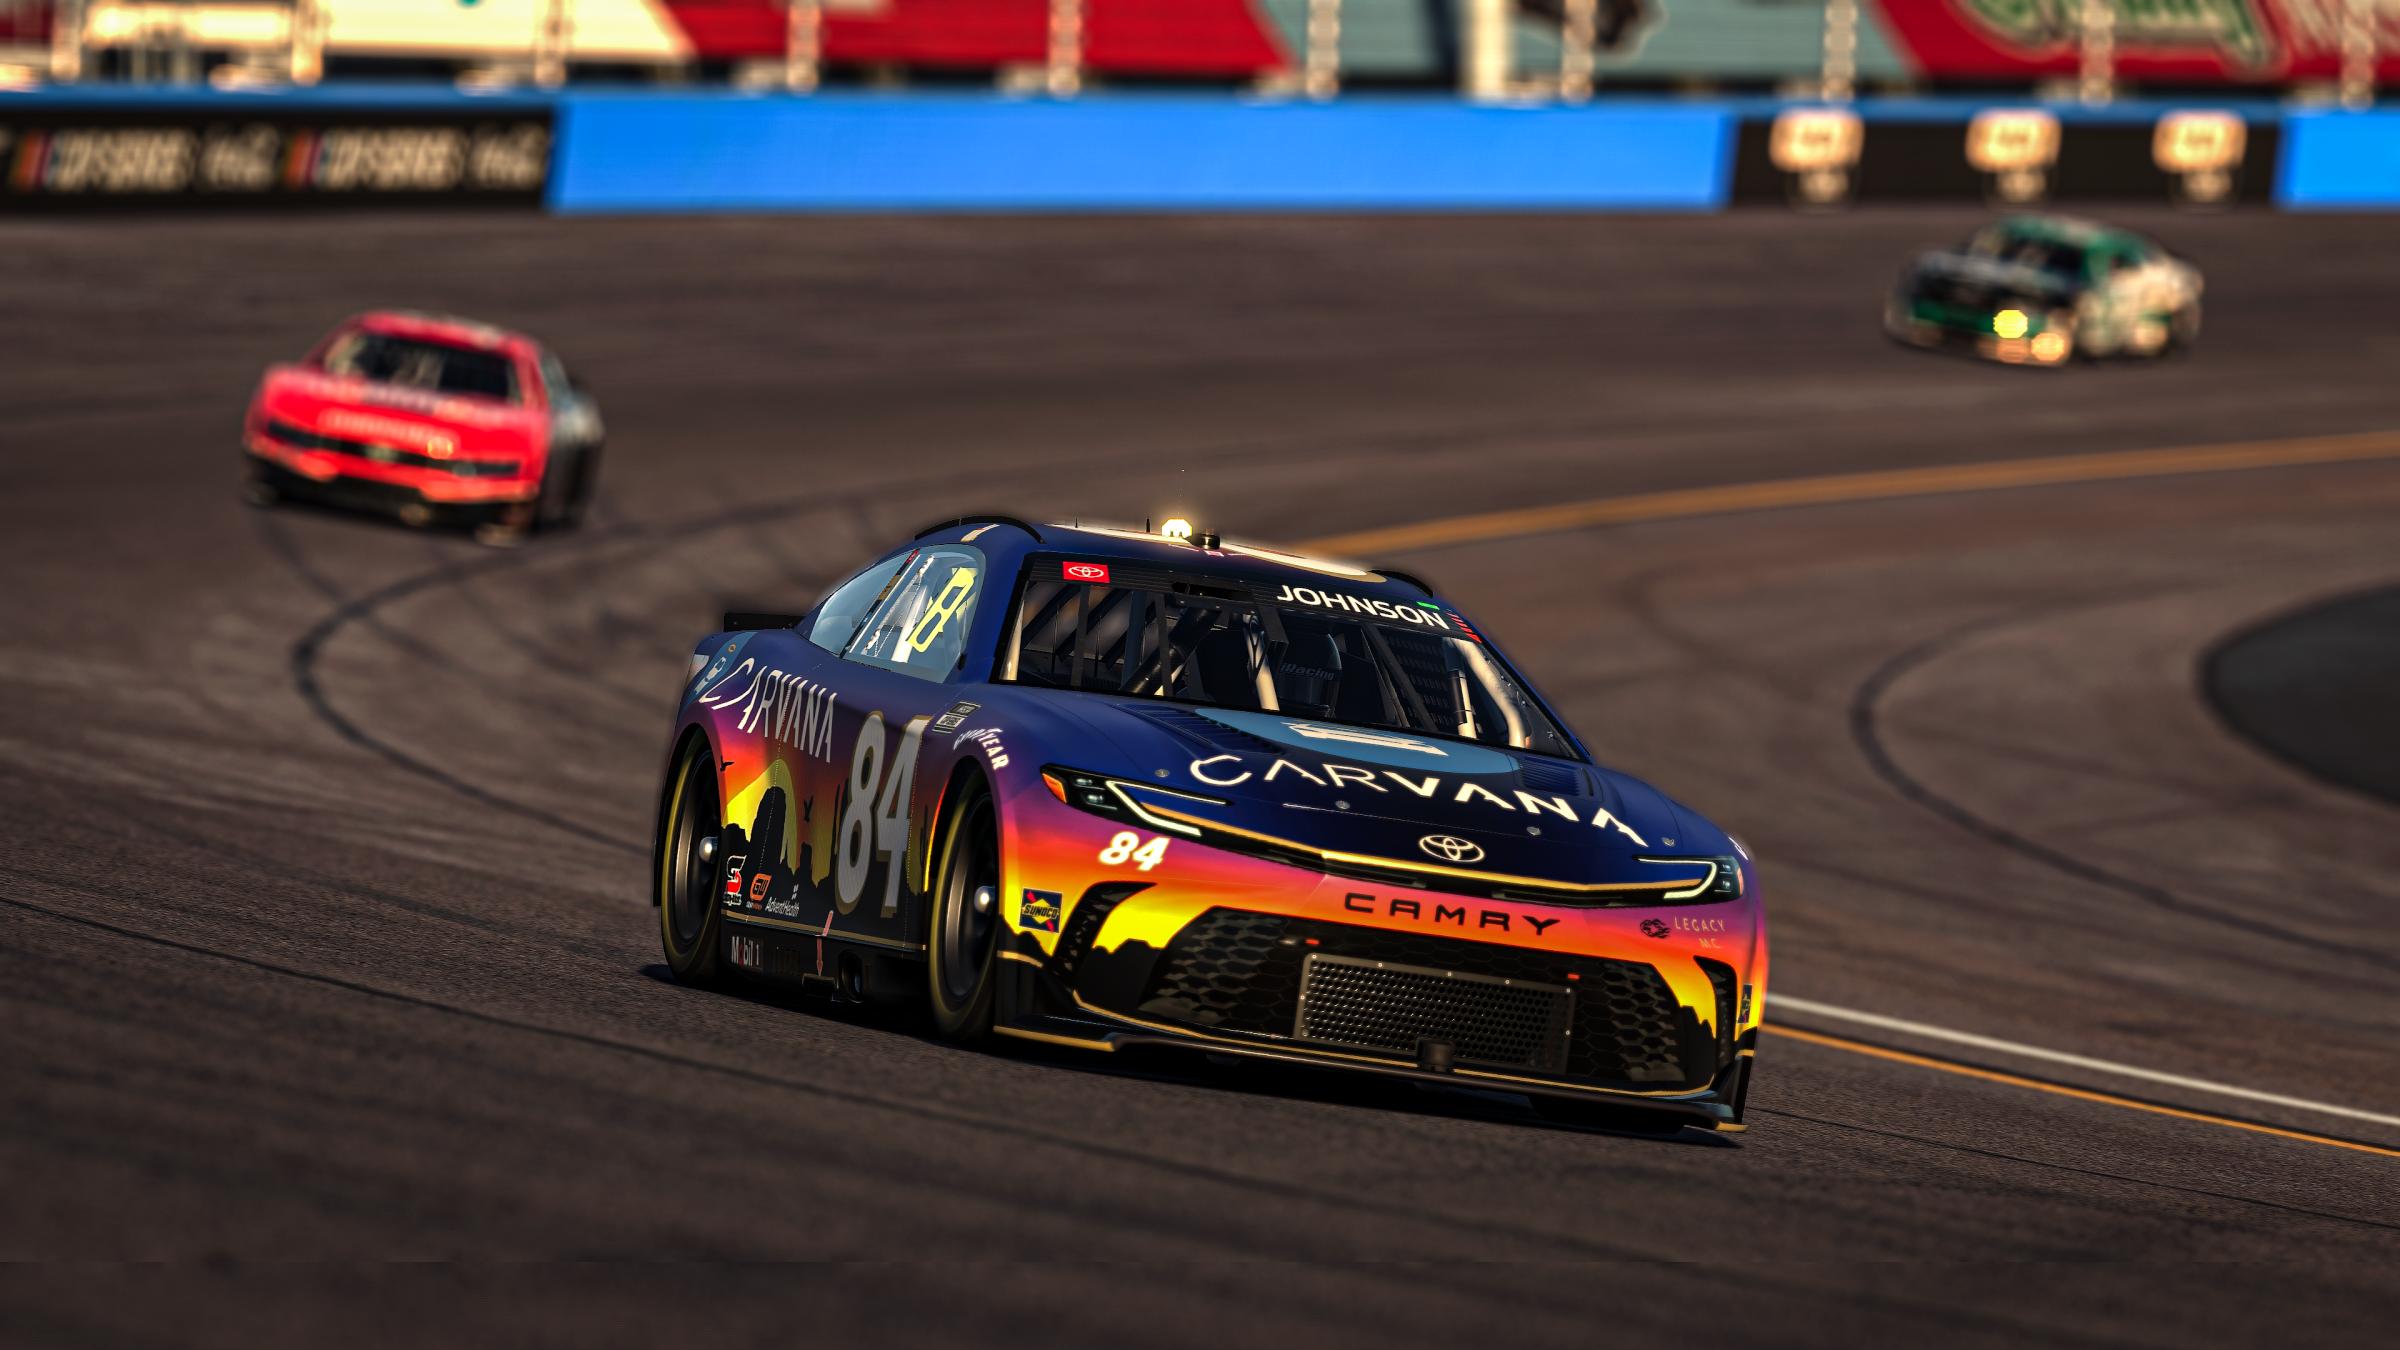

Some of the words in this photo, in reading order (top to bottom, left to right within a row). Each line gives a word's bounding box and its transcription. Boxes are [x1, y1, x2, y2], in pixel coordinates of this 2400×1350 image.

[1277, 585, 1450, 629] JOHNSON
[699, 657, 837, 763] CARVANA
[836, 712, 931, 913] 84
[1191, 755, 1648, 847] CARVANA
[1098, 831, 1171, 871] 84
[1344, 892, 1561, 936] CAMRY
[1674, 916, 1726, 932] LEGACY
[731, 935, 754, 967] Mobil
